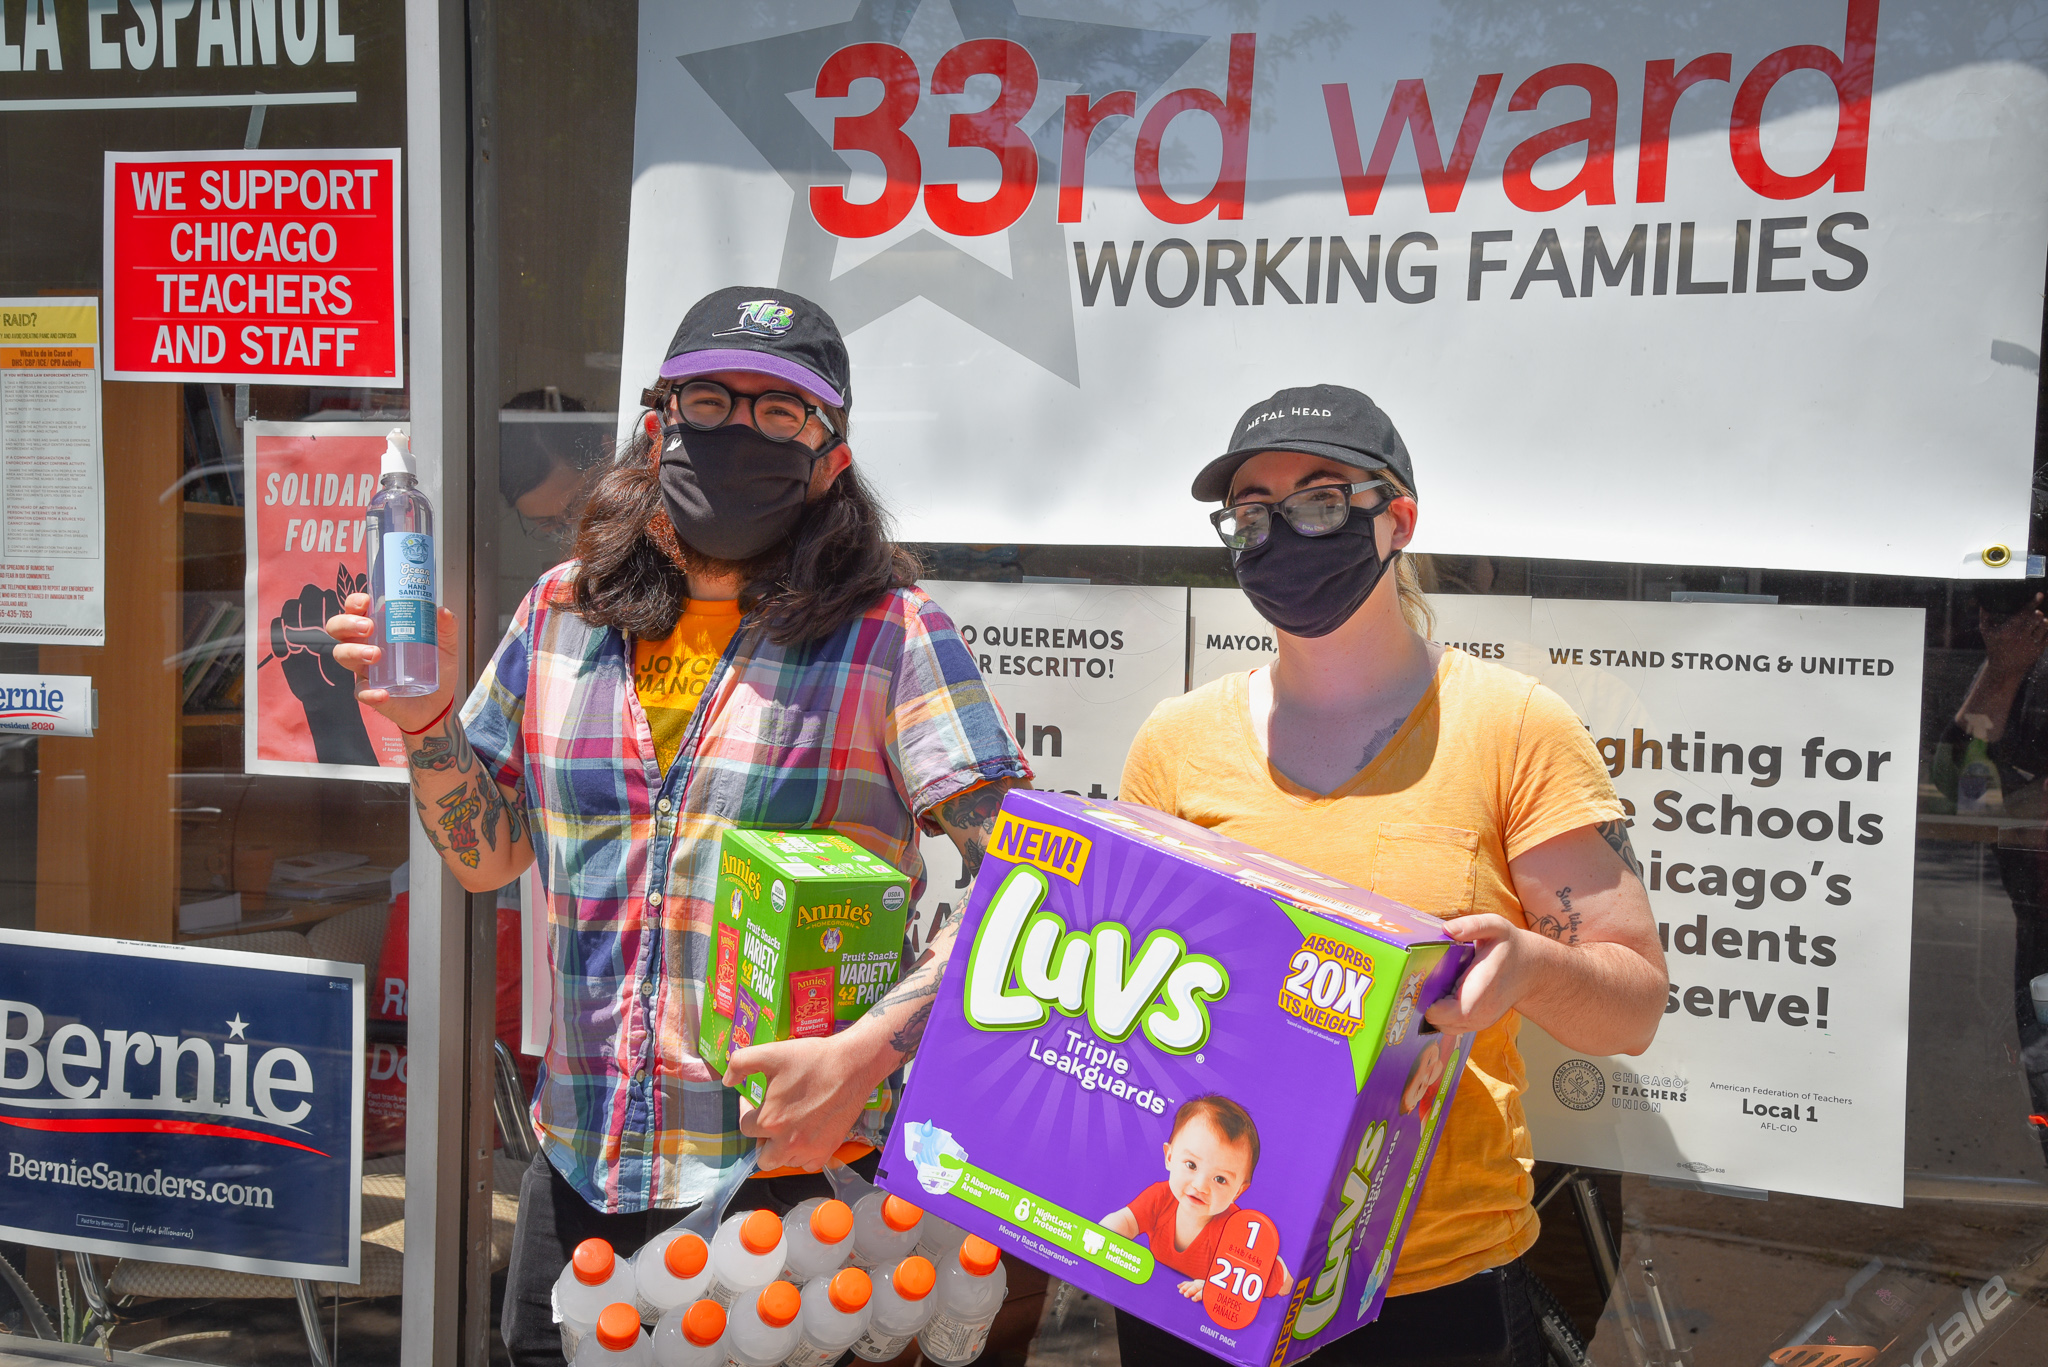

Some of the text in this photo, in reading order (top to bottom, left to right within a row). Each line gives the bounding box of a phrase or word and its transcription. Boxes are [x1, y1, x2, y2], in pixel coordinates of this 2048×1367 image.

[808, 0, 1879, 240] 33rd ward
[131, 169, 379, 211] WE SUPPORT
[170, 221, 338, 263] CHICAGO
[1073, 211, 1870, 307] WORKING FAMILIES
[156, 273, 353, 315] TEACHERS
[3, 312, 38, 327] RAID?
[150, 325, 359, 367] AND STAFF
[1246, 406, 1332, 432] METAL HEAD
[399, 573, 431, 587] Fresh
[400, 562, 431, 577] Ocean
[398, 589, 433, 599] SANITIZER
[407, 583, 427, 591] HAND
[983, 626, 1124, 651] QUEREMOS
[1206, 634, 1279, 655] MAYOR,
[999, 655, 1115, 679] ESCRITO!
[1549, 647, 1895, 677] WE STAND STRONG & UNITED
[0, 721, 55, 732] resident 2020
[1586, 726, 1892, 788] ghting for
[1652, 789, 1884, 846] Schools
[996, 820, 1083, 874] NEW!
[720, 848, 762, 902] Annie's
[796, 898, 873, 928] Annie's
[811, 919, 856, 929] HOMEGROWN
[746, 917, 781, 951] Fruit Snacks
[743, 931, 780, 977] VARIETY
[841, 950, 899, 962] Fruit Snacks
[964, 866, 1229, 1054] Luvs
[1305, 935, 1373, 973] ABSORBS
[741, 959, 776, 1004] 42 PACK
[796, 976, 828, 991] Annie's
[839, 960, 897, 986] VARIETY
[1285, 951, 1374, 1020] 20X
[837, 986, 857, 1001] 42
[1280, 991, 1302, 1016] ITS
[796, 1022, 829, 1033] Strawberry
[800, 1017, 824, 1027] Summer
[0, 999, 314, 1126] Bernie
[1065, 1029, 1130, 1076] Triple
[1555, 1066, 1567, 1093] CHICAGO
[1567, 1061, 1599, 1076] TEACHERS
[1612, 1071, 1684, 1089] CHICAGO
[1562, 1097, 1571, 1106] AFT
[1611, 1097, 1661, 1113] UNION
[1612, 1085, 1687, 1102] TEACHERS
[1710, 1081, 1853, 1105] American Federation of Teachers
[1741, 1097, 1819, 1122] Local 1
[1760, 1121, 1798, 1133] AFL-CIO
[8, 1152, 275, 1209] BernieSanders.com
[961, 1182, 983, 1199] Areas
[964, 1173, 1010, 1201] 3 Absorption
[131, 1222, 194, 1240] (not the billionaires)
[998, 1223, 1021, 1244] Money
[1021, 1234, 1038, 1250] Back
[1032, 1216, 1073, 1242] Protection
[1246, 1221, 1262, 1250] 1
[1105, 1251, 1141, 1275] Indicator
[1108, 1242, 1142, 1265] Wetness
[1208, 1257, 1264, 1303] 210
[1212, 1303, 1240, 1324] PAÑALES
[1216, 1292, 1243, 1313] DIAPERS
[1199, 1324, 1237, 1349] GIANT PACK
